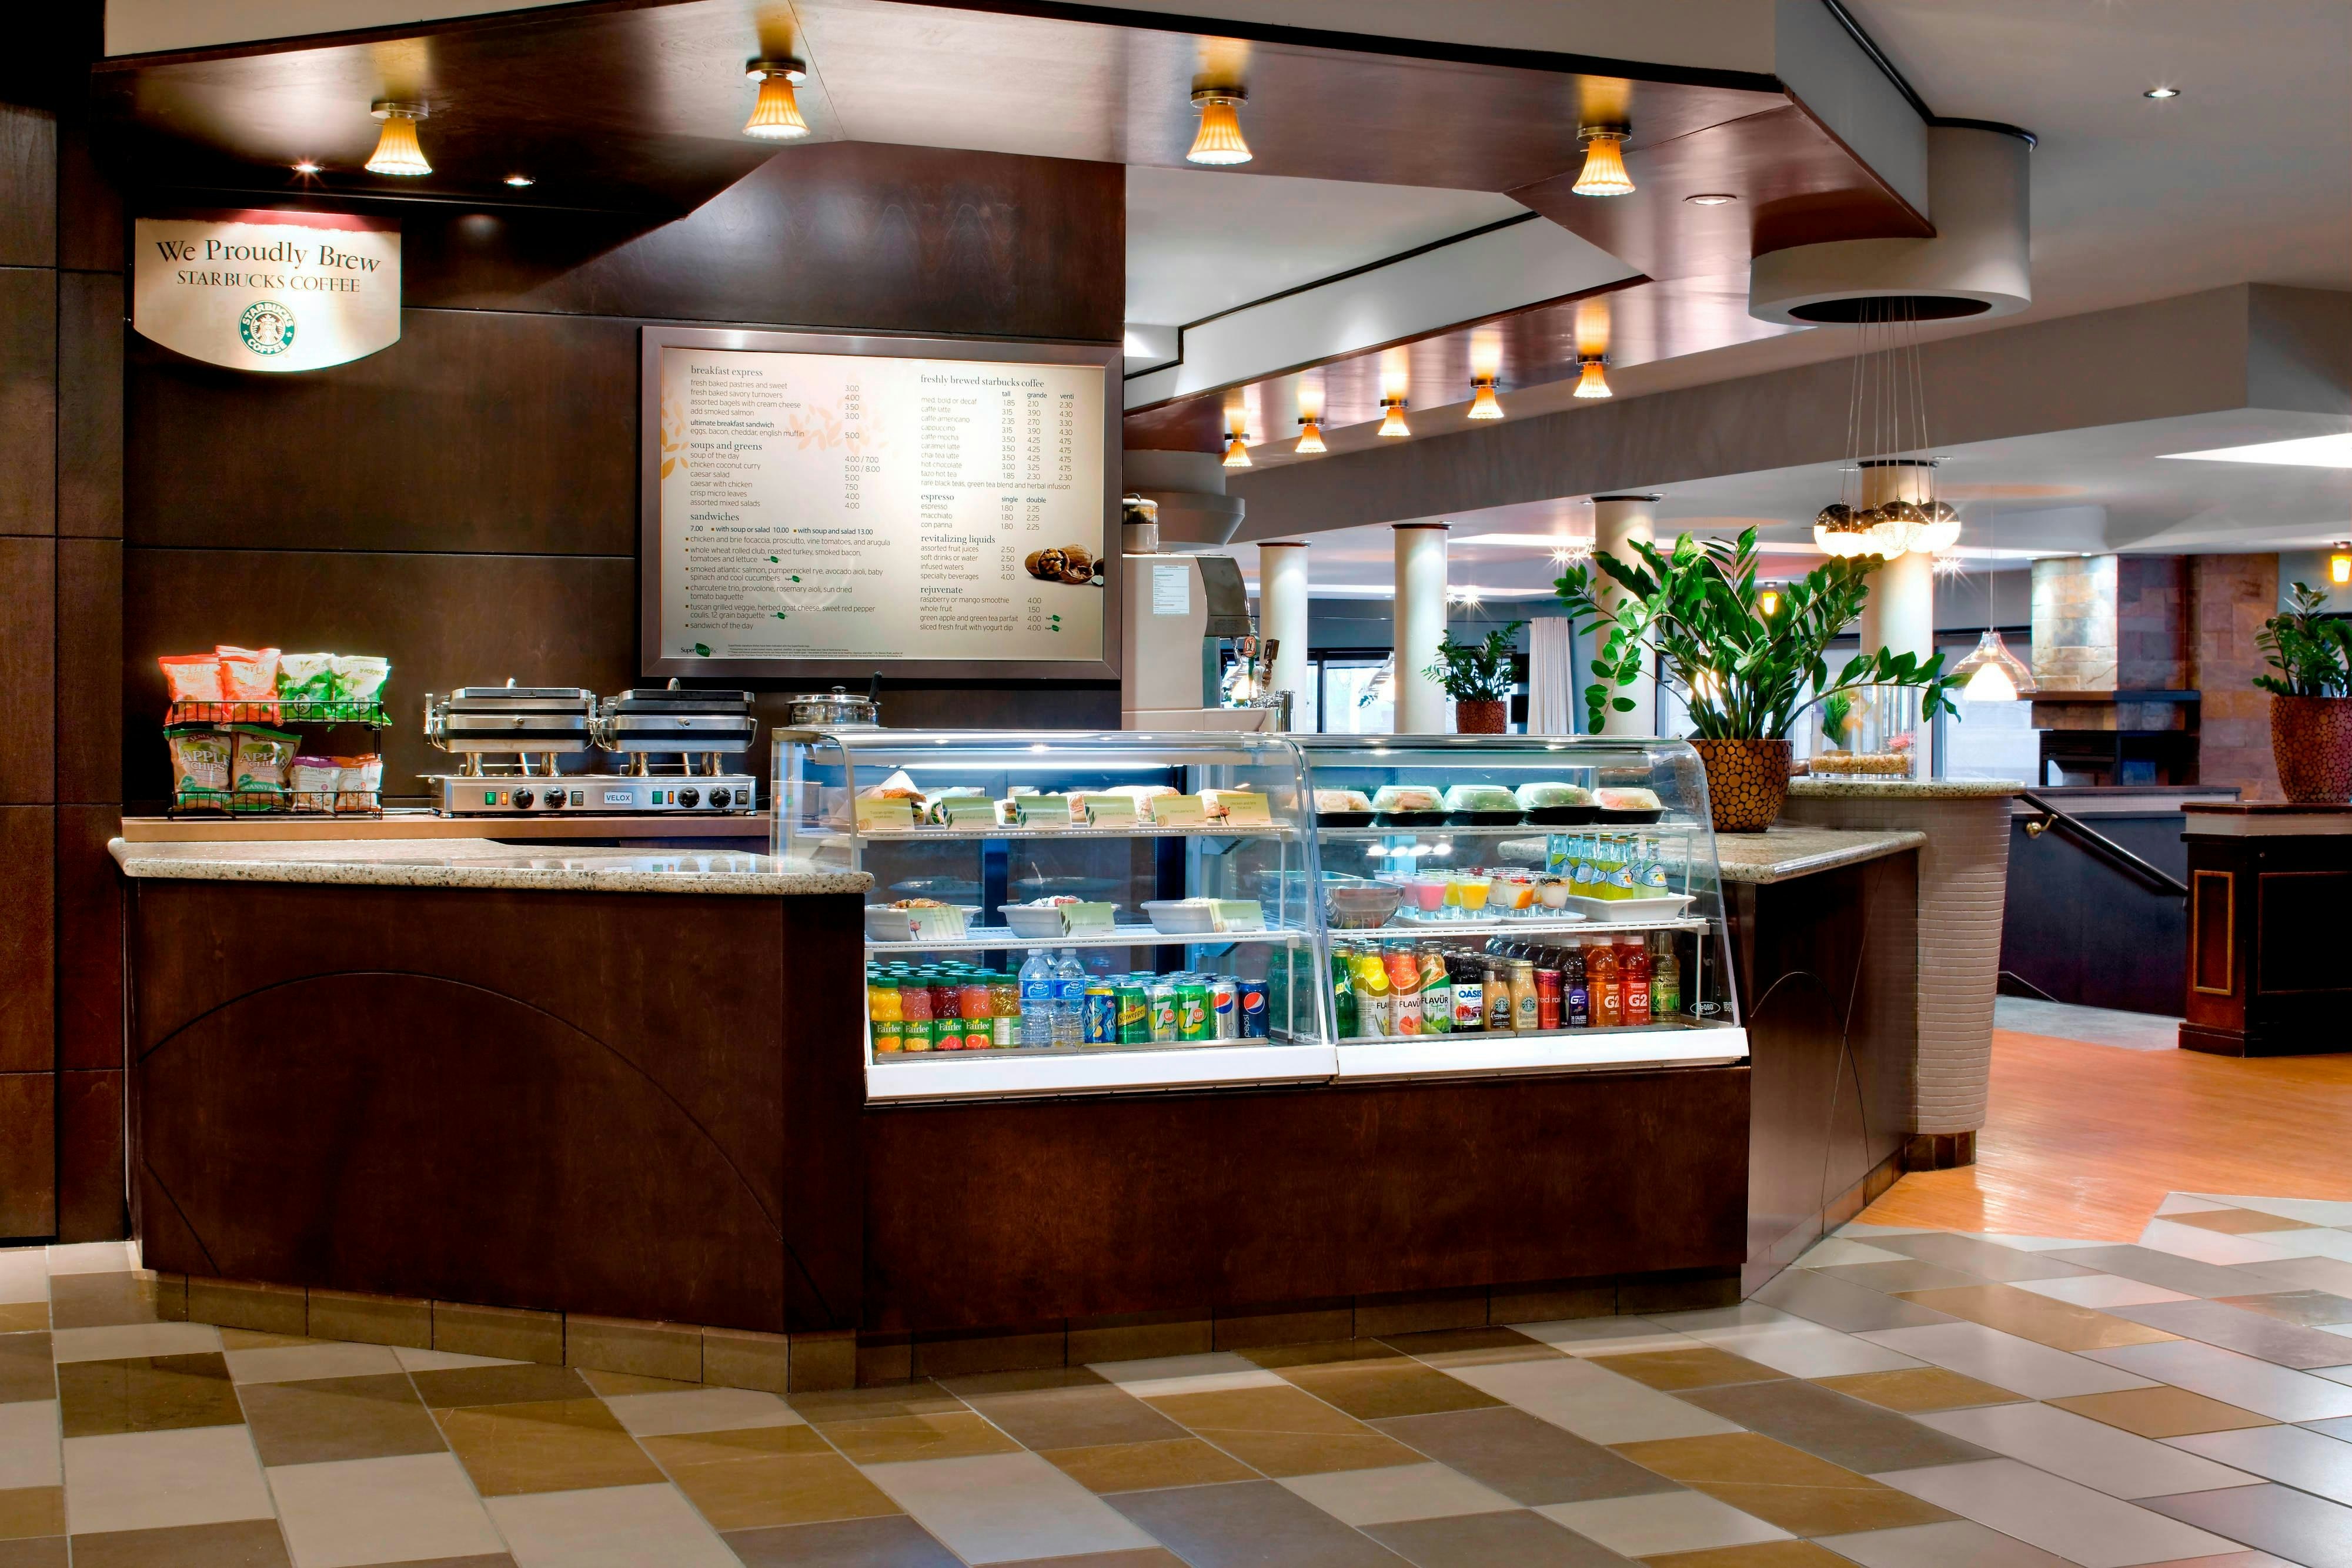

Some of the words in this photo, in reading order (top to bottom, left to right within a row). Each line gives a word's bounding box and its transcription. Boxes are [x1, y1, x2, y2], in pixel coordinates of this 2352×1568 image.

[156, 240, 196, 263] We
[205, 239, 309, 270] Proudly
[318, 245, 382, 273] Brew
[177, 270, 285, 289] STARBUCKS
[290, 275, 360, 293] COFFEE
[242, 303, 295, 327] STARBUCKS
[248, 339, 288, 354] COFFEE
[691, 366, 729, 376] breakfast
[731, 369, 763, 378] express
[921, 374, 948, 386] freshly
[950, 375, 980, 385] brewed
[981, 376, 1020, 386] starbucks
[1021, 378, 1044, 387] coffee
[691, 389, 707, 397] fresh
[1027, 391, 1048, 400] grande
[690, 398, 718, 406] assorted
[719, 399, 740, 409] bagels
[778, 400, 801, 409] cheese
[690, 419, 716, 427] ultimate
[716, 419, 744, 427] breakfast
[690, 443, 714, 452] soups
[716, 441, 731, 450] and
[734, 443, 763, 453] greens
[690, 460, 714, 469] chicken
[740, 499, 761, 507] salads
[921, 494, 954, 503] espresso
[1001, 495, 1018, 504] single
[690, 511, 740, 521] sandwiches
[921, 533, 967, 544] revitalizing
[969, 534, 995, 545] liquids
[767, 546, 791, 554] roasted
[961, 544, 979, 553] juices
[920, 571, 947, 580] specialty
[947, 571, 979, 581] beverages
[920, 585, 963, 596] rejuvenate
[920, 595, 949, 604] raspberry
[713, 603, 732, 611] grilled
[781, 604, 796, 613] goat
[920, 604, 938, 612] whole
[719, 611, 735, 620] grain
[736, 611, 765, 620] baguette
[741, 621, 753, 631] day
[983, 623, 1002, 632] yogurt
[1003, 623, 1013, 632] dip
[181, 750, 230, 766] APPLE
[191, 761, 226, 773] CHIPS
[1421, 994, 1448, 1004] FLAVÜR
[1458, 990, 1482, 998] OASIS
[1538, 994, 1549, 1003] red
[1399, 998, 1421, 1008] FLAVÜ
[1570, 995, 1586, 1004] G2
[1604, 995, 1620, 1008] G2
[1628, 994, 1648, 1007] G2
[1152, 1000, 1171, 1030] 7
[1182, 1000, 1201, 1029] 7
[877, 1024, 901, 1033] Fairlee
[906, 1025, 930, 1033] Fairlee
[939, 1023, 962, 1031] Fairlee
[967, 1021, 990, 1030] Fairlee
[1243, 1014, 1251, 1038] pepsi
